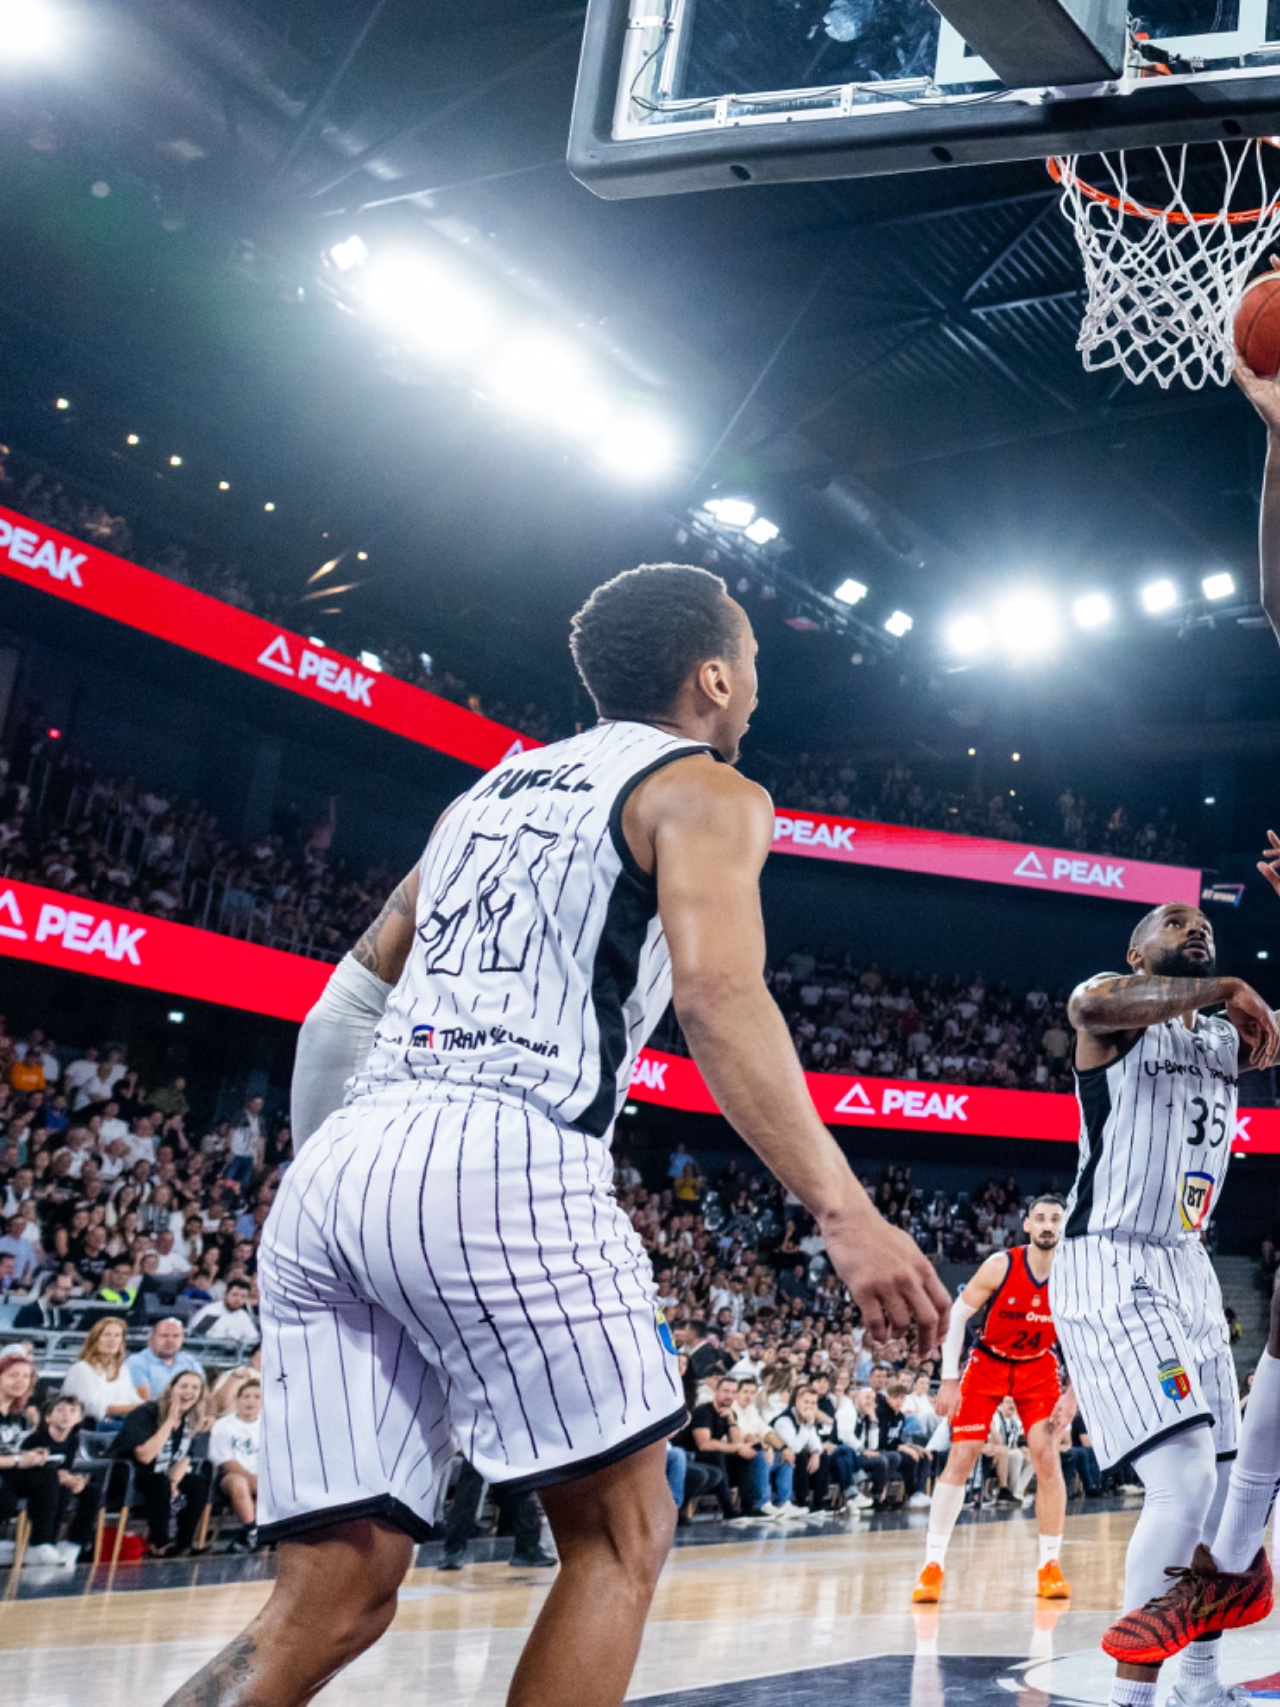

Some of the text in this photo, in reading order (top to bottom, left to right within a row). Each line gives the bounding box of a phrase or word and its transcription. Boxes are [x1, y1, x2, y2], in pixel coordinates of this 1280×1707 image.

[298, 649, 375, 707] PEAK
[773, 815, 855, 852] PEAK
[1053, 857, 1124, 889] PEAK
[35, 903, 147, 966] PEAK
[629, 1055, 669, 1091] EAK
[882, 1089, 969, 1121] PEAK
[1187, 1097, 1227, 1148] 35
[1187, 1185, 1206, 1209] BT
[1010, 1330, 1042, 1349] 24
